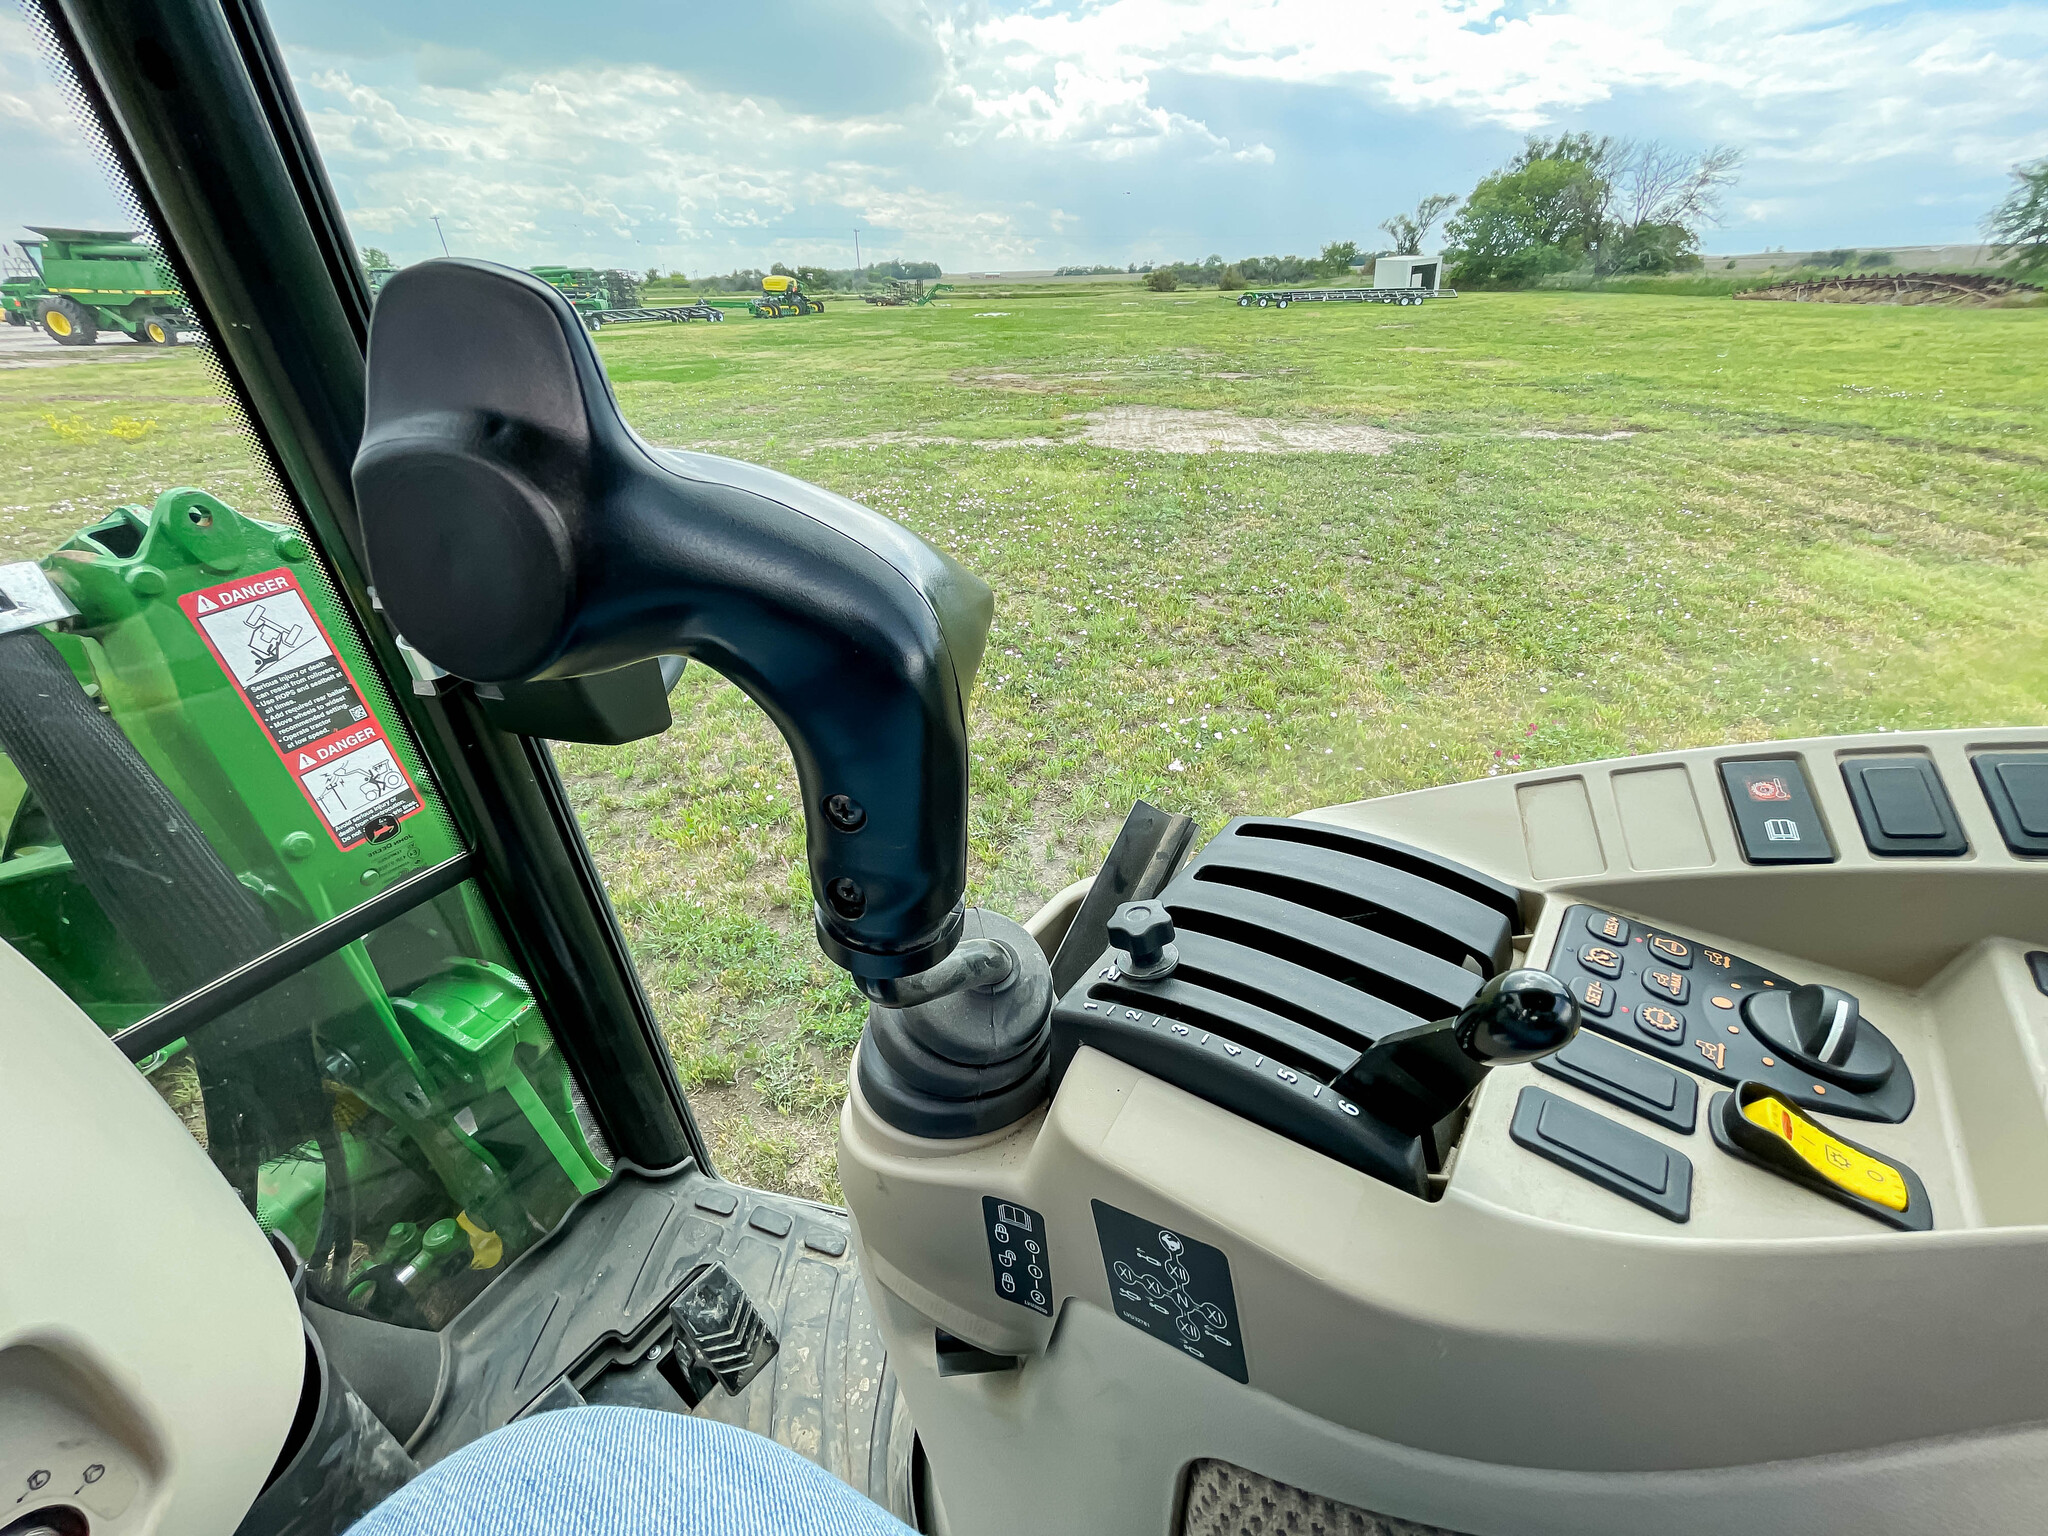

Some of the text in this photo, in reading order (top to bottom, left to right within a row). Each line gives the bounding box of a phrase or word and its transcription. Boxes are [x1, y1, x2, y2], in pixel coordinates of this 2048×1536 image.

[218, 576, 290, 607] DANGER
[250, 679, 279, 693] Serious
[279, 671, 300, 682] injury
[307, 661, 327, 672] death
[255, 666, 338, 700] can result from rollovers.
[260, 697, 276, 707] Use
[275, 689, 297, 701] ROPS
[297, 683, 310, 693] and
[309, 674, 336, 688] seatbelt
[265, 700, 296, 714] all times.
[269, 686, 350, 721] Add required rear ballast.
[273, 717, 293, 729] Move
[293, 708, 317, 721] wheels
[325, 695, 346, 708] widest
[278, 703, 350, 735] recommended setting.
[282, 718, 332, 742] Operate tractor
[295, 736, 308, 745] low
[308, 727, 330, 740] speed.
[316, 727, 377, 760] DANGER
[335, 820, 352, 832] Avoid
[352, 809, 374, 822] serious
[374, 800, 391, 813] injury
[338, 826, 355, 837] death
[355, 819, 369, 829] from
[341, 835, 352, 843] Do
[351, 830, 362, 838] not
[1083, 1002, 1361, 1117] 1 2 3 4 5 6
[1176, 1292, 1189, 1308] N
